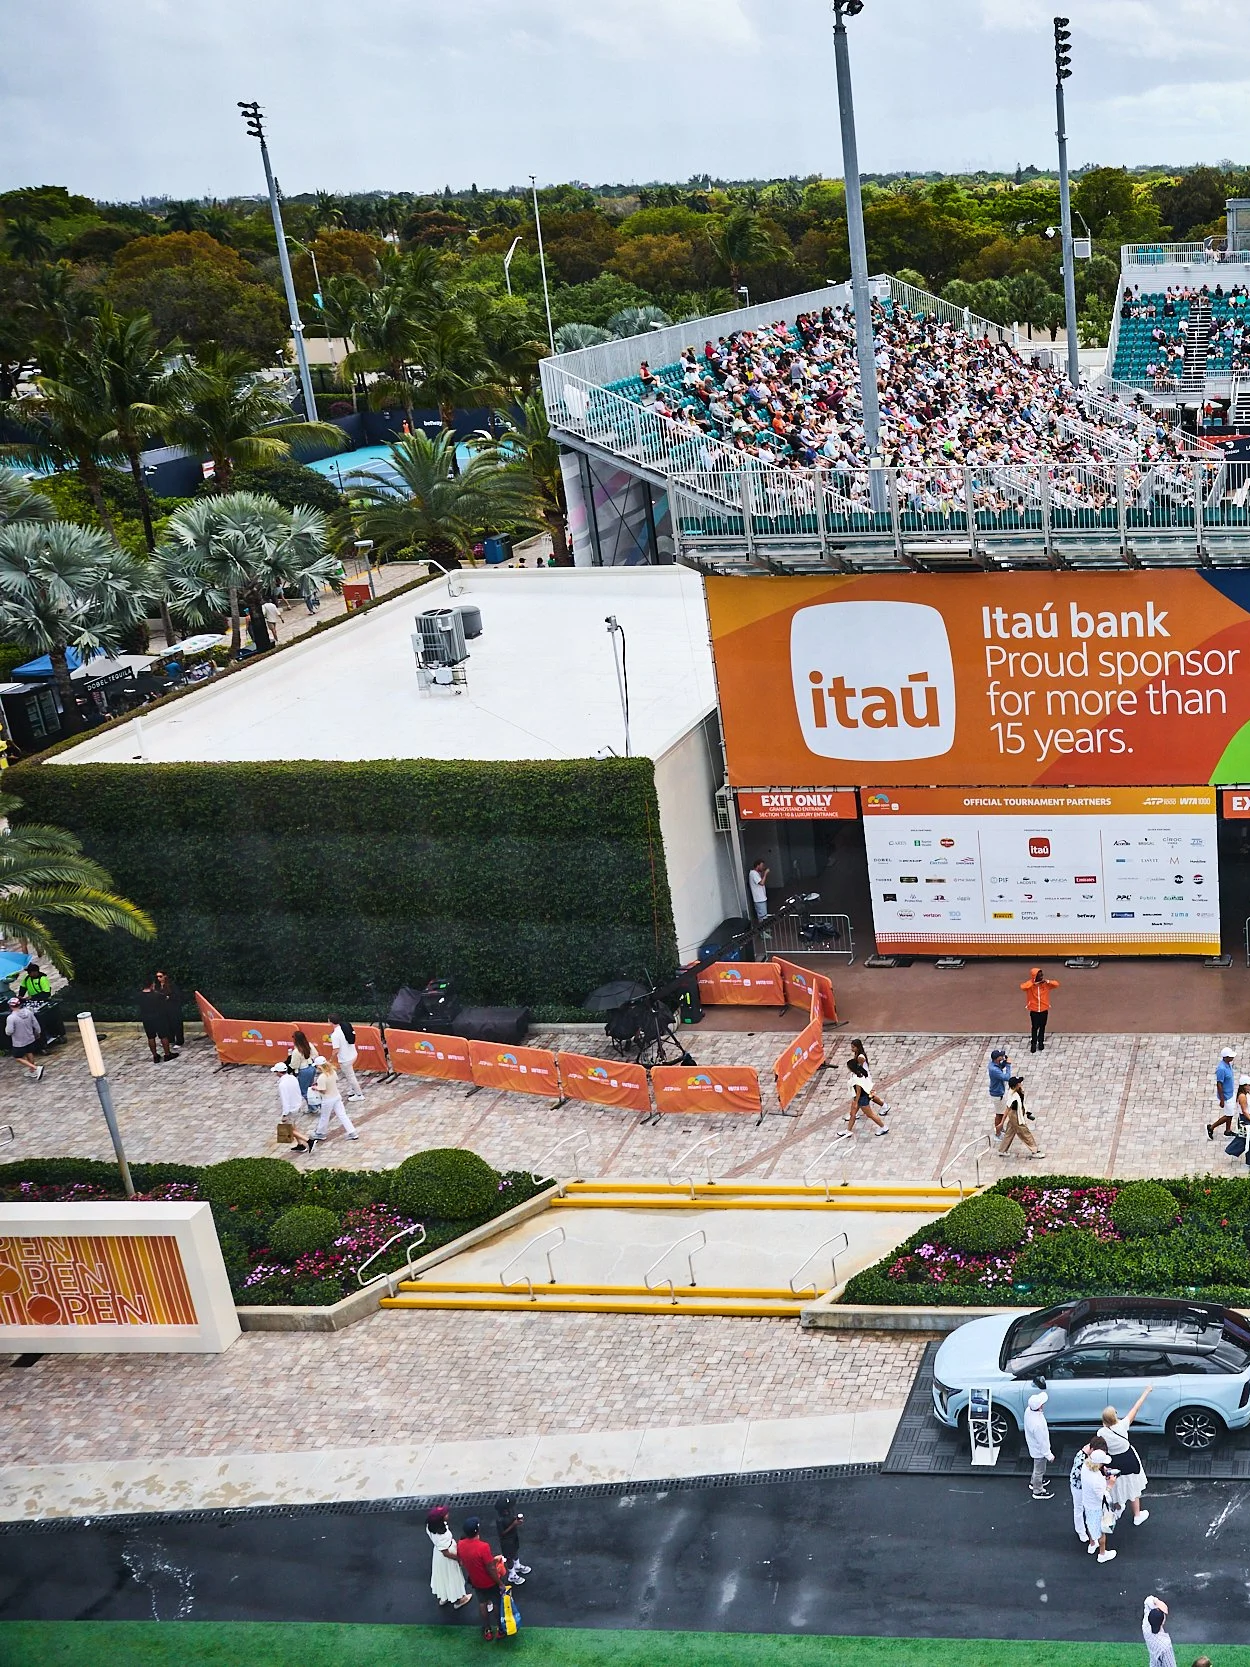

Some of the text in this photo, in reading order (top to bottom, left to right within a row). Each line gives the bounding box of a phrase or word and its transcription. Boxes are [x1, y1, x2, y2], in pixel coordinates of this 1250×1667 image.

[981, 601, 1171, 639] Itaú bank
[87, 668, 132, 691] DOBEL TEQUILA
[985, 642, 1240, 685] Proud sponsor
[808, 670, 940, 729] itaú
[986, 679, 1227, 716] for more than
[989, 722, 1134, 762] 15 years.
[761, 794, 833, 807] EXIT ONLY
[963, 797, 1112, 806] OFFICIAL TOURNAMENT PARTNERS
[1030, 845, 1049, 854] itaú
[26, 1294, 151, 1325] OPEN
